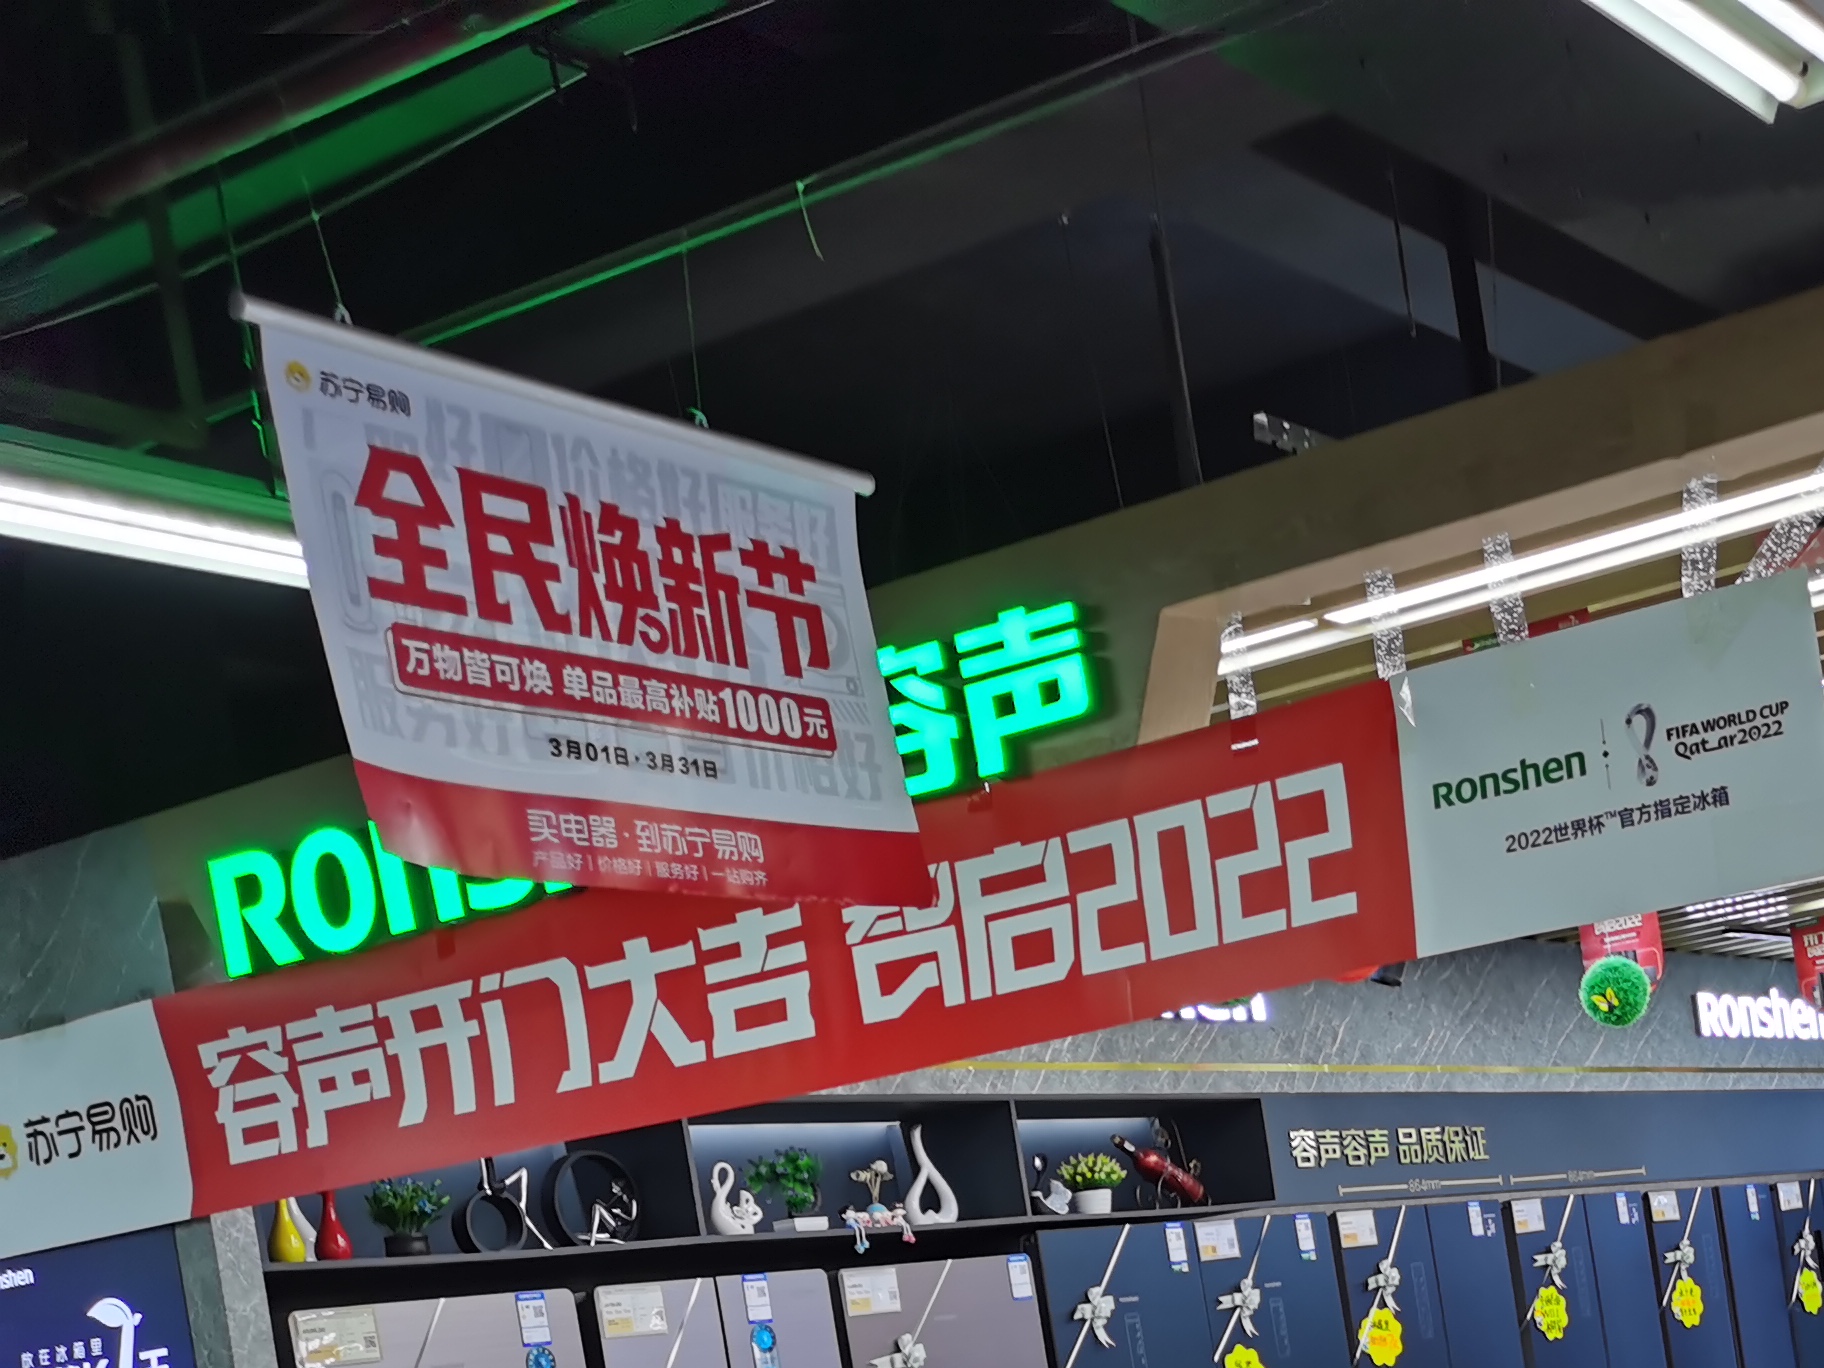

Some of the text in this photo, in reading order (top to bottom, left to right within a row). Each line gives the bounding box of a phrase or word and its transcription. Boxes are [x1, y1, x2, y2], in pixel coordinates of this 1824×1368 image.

[319, 369, 412, 418] 苏宁易购
[354, 443, 832, 680] 全民焕新节
[401, 637, 555, 698] 万物皆可焕
[562, 664, 831, 742] 单品最高补贴1000元
[877, 600, 1091, 798] 容声
[1665, 699, 1790, 742] FIFA WORLD CUP
[1431, 748, 1588, 810] Ronshen
[198, 902, 816, 1168] 容声开门大吉
[24, 1092, 160, 1167] 苏宁易购
[1288, 1125, 1490, 1169] 容声容声 品质保证
